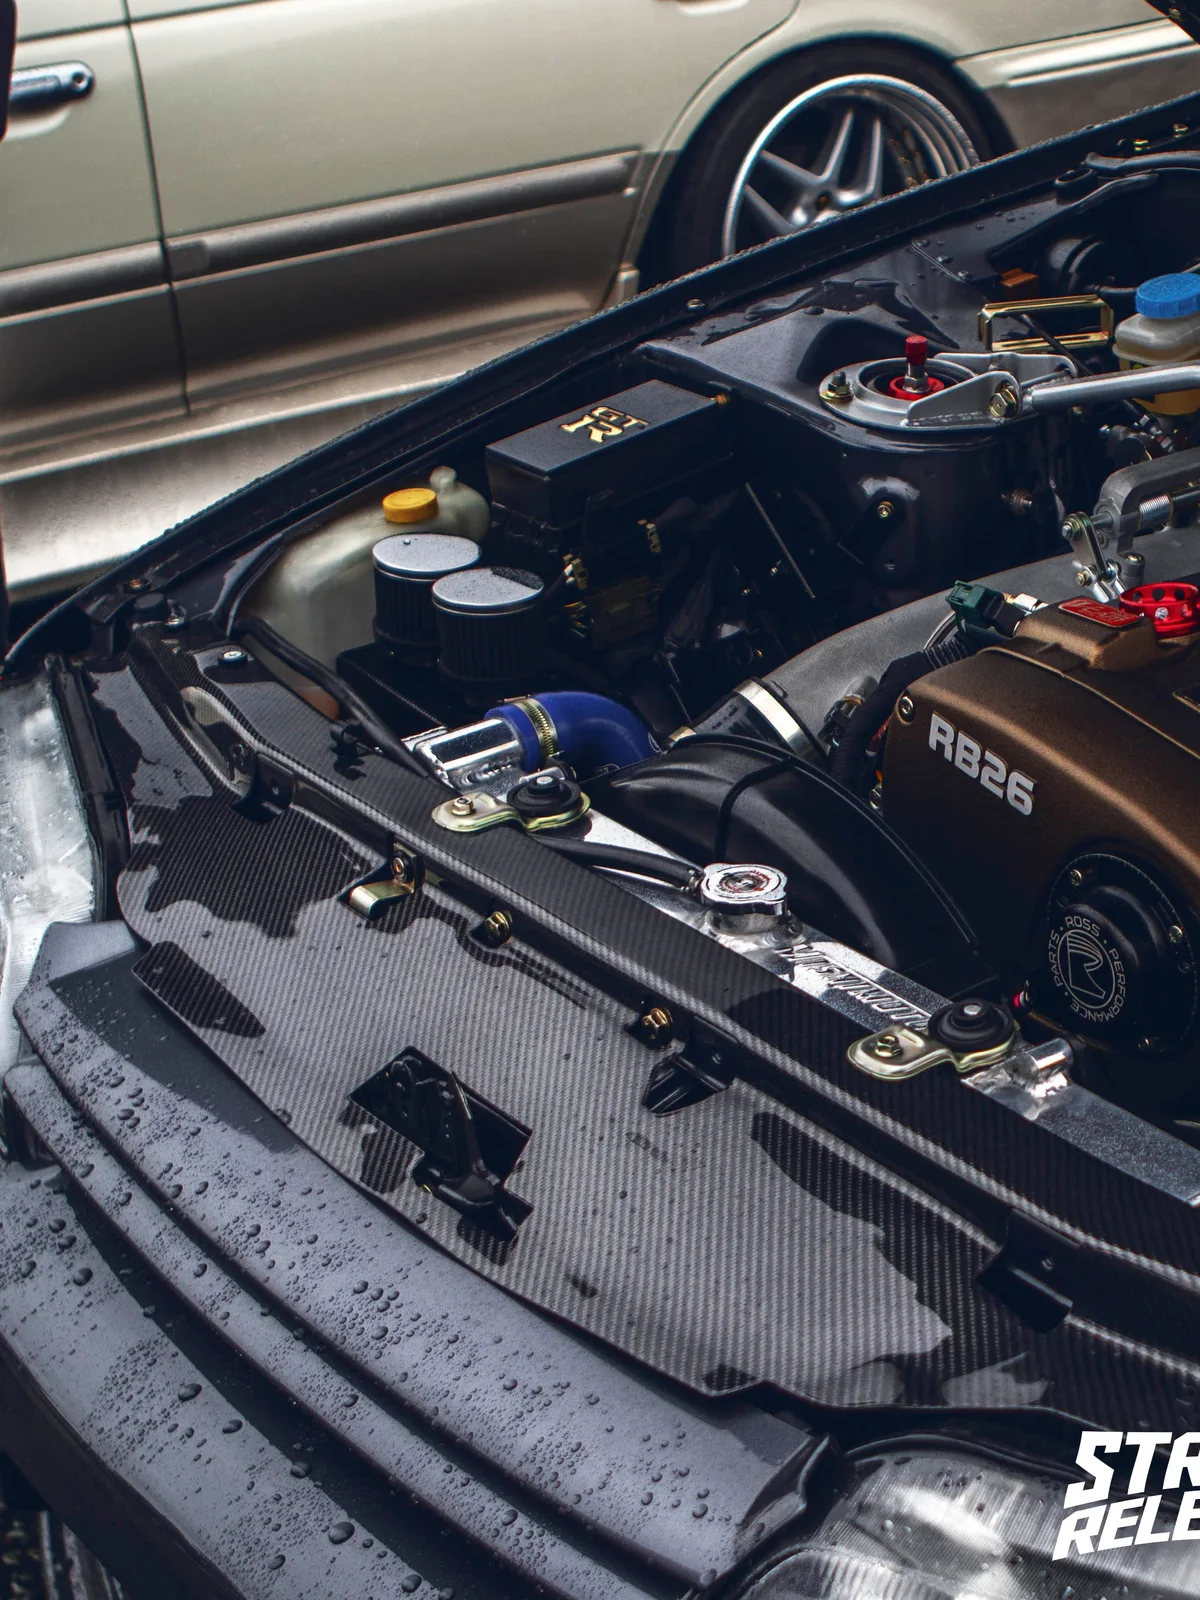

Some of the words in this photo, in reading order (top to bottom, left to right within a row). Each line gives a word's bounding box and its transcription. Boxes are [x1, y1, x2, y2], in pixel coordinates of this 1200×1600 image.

[929, 711, 1037, 816] RB26
[1048, 929, 1064, 987] PARTS
[1064, 915, 1101, 937] ROSS
[1070, 947, 1127, 1022] PERFORMANCE
